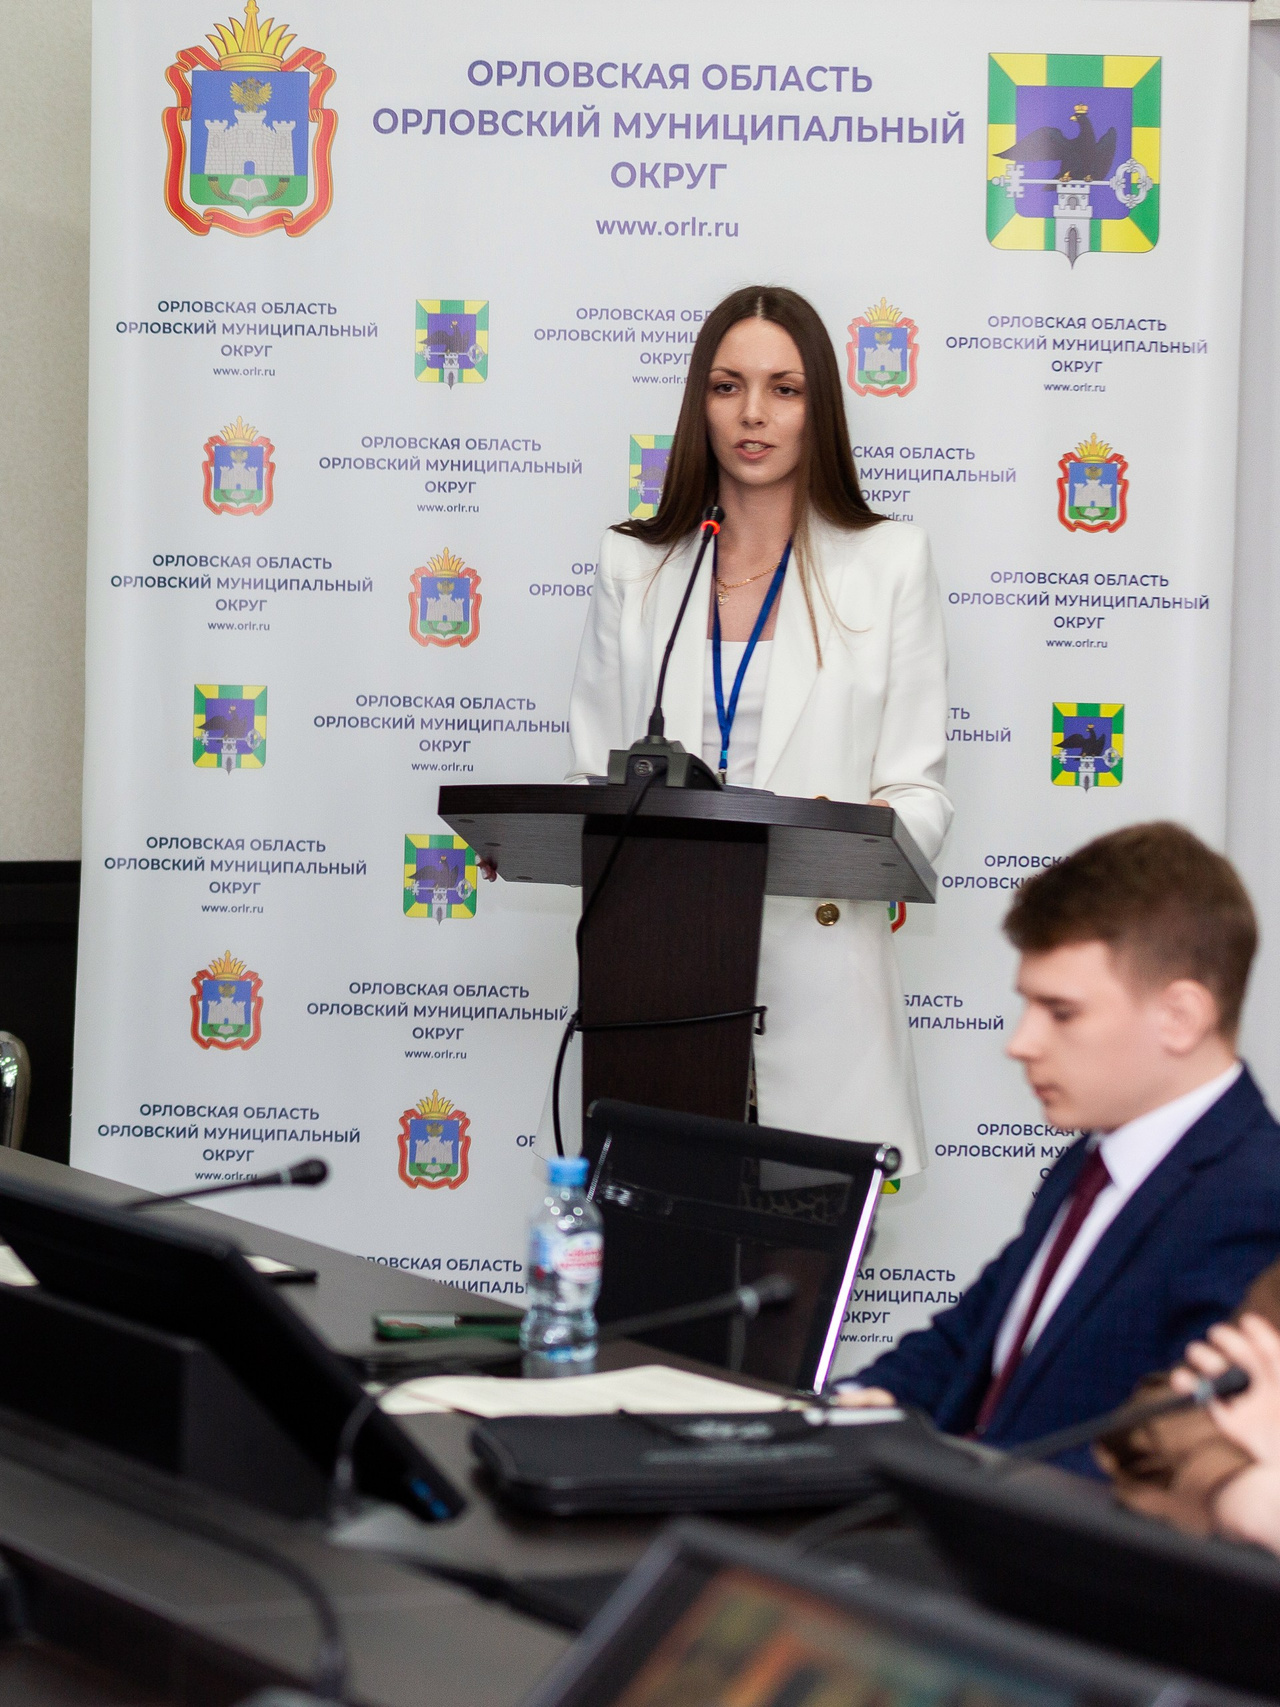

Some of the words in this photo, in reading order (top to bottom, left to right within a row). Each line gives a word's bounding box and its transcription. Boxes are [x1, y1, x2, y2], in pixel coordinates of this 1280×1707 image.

[468, 60, 689, 89] ОРЛОВСКАЯ
[702, 64, 872, 92] ОБЛАСТЬ
[373, 105, 599, 137] ОРЛОВСКИЙ
[614, 111, 964, 145] МУНИЦИПАЛЬНЫЙ
[611, 162, 727, 189] ОКРУГ
[596, 217, 738, 237] www.orlr.ru
[158, 301, 255, 313] ОРЛОВСКАЯ
[262, 302, 337, 314] ОБЛАСТЬ
[576, 308, 675, 321] ОРЛОВСКАЯ
[116, 320, 216, 334] ОРЛОВСКИЙ
[223, 323, 377, 338] МУНИЦИПАЛЬНЫЙ
[988, 316, 1086, 329] ОРЛОВСКАЯ
[1092, 318, 1166, 331] ОБЛАСТЬ
[534, 328, 635, 342] ОРЛОВСКИЙ
[221, 345, 272, 357] ОКРУГ
[946, 336, 1046, 349] ОРЛОВСКИЙ
[1053, 339, 1206, 353] МУНИЦИПАЛЬНЫЙ
[213, 367, 275, 376] www.orlr.ru
[1052, 360, 1102, 372] ОКРУГ
[1044, 383, 1105, 392] www.orlr.ru
[362, 436, 460, 450] ОРЛОВСКАЯ
[465, 438, 541, 451] ОБЛАСТЬ
[900, 447, 975, 459] ОБЛАСТЬ
[319, 456, 420, 470] ОРЛОВСКИЙ
[426, 459, 582, 474] МУНИЦИПАЛЬНЫЙ
[860, 468, 1015, 483] МУНИЦИПАЛЬНЫЙ
[425, 481, 476, 493] ОКРУГ
[860, 489, 911, 502] ОКРУГ
[417, 503, 479, 512] www.orlr.ru
[153, 555, 250, 567] ОРЛОВСКАЯ
[257, 557, 332, 569] ОБЛАСТЬ
[111, 574, 211, 588] ОРЛОВСКИЙ
[217, 577, 372, 592] МУНИЦИПАЛЬНЫЙ
[991, 572, 1088, 585] ОРЛОВСКАЯ
[1094, 574, 1168, 586] ОБЛАСТЬ
[216, 599, 267, 611] ОКРУГ
[949, 591, 1049, 606] ОРЛОВСКИЙ
[1055, 595, 1209, 609] МУНИЦИПАЛЬНЫЙ
[208, 622, 270, 630] www.orlr.ru
[1054, 616, 1105, 628] ОКРУГ
[1046, 639, 1107, 648] www.orlr.ru
[356, 695, 454, 708] ОРЛОВСКАЯ
[460, 697, 536, 710] ОБЛАСТЬ
[314, 715, 414, 729] ОРЛОВСКИЙ
[420, 717, 570, 734] МУНИЦИПАЛЬНЫ
[419, 740, 471, 752] ОКРУГ
[412, 763, 473, 771] www.orlr.ru
[147, 837, 244, 850] ОРЛОВСКАЯ
[250, 839, 326, 852] ОБЛАСТЬ
[105, 857, 204, 871] ОРЛОВСКИЙ
[211, 860, 366, 875] МУНИЦИПАЛЬНЫЙ
[984, 855, 1062, 868] ОРЛОВСК
[209, 882, 261, 894] ОКРУГ
[942, 876, 1021, 889] ОРЛОВСК
[201, 904, 263, 913] www.orlr.ru
[349, 982, 448, 996] ОРЛОВСКАЯ
[454, 985, 529, 998] ОБЛАСТЬ
[307, 1002, 408, 1017] ОРЛОВСКИЙ
[414, 1006, 568, 1021] МУНИЦИПАЛЬНЫЙ
[909, 1016, 1003, 1030] ИПАЛЬНЫЙ
[413, 1027, 464, 1039] ОКРУГ
[405, 1050, 466, 1059] www.orlr.ru
[140, 1104, 238, 1118] ОРЛОВСКАЯ
[244, 1107, 319, 1120] ОБЛАСТЬ
[98, 1124, 198, 1138] ОРЛОВСКИЙ
[204, 1128, 360, 1143] МУНИЦИПАЛЬНЫЙ
[203, 1149, 254, 1161] ОКРУГ
[935, 1143, 1035, 1157] ОРЛОВСКИЙ
[447, 1259, 522, 1272] ОБЛАСТЬ
[880, 1269, 955, 1281] ОБЛАСТЬ
[840, 1333, 893, 1342] ww.orlr.ru
